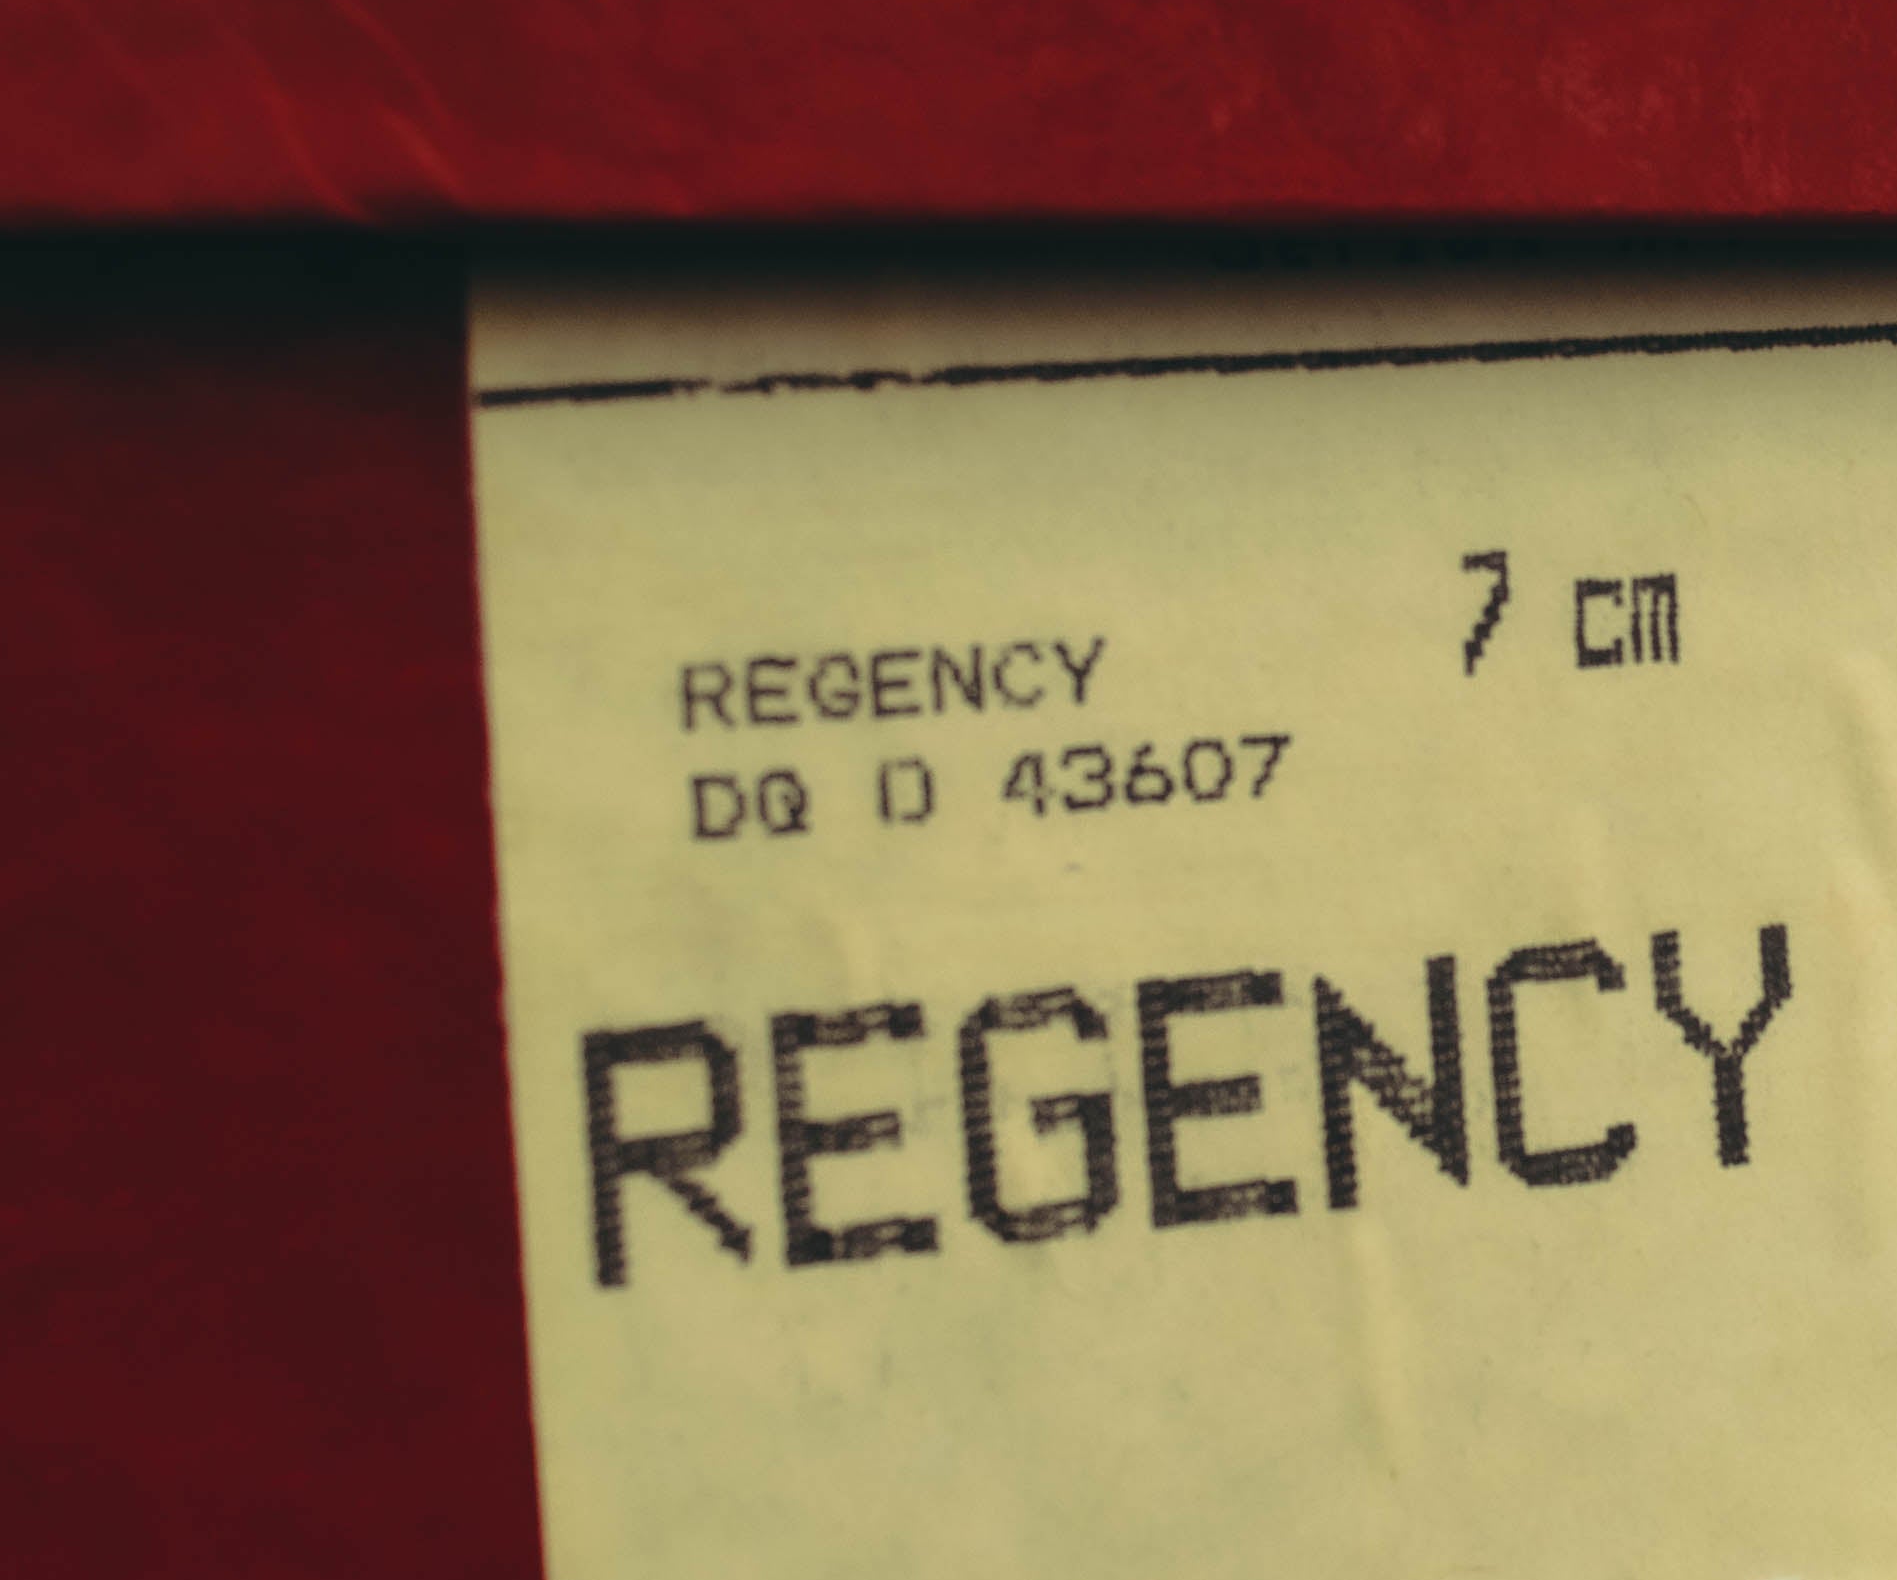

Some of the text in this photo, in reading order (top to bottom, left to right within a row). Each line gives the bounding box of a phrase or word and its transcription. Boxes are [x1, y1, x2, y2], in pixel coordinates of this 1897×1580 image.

[1461, 549, 1509, 677] 7
[681, 636, 1107, 732] REGENCY
[1001, 733, 1292, 818] 43607
[581, 923, 1791, 1288] REGENCY
